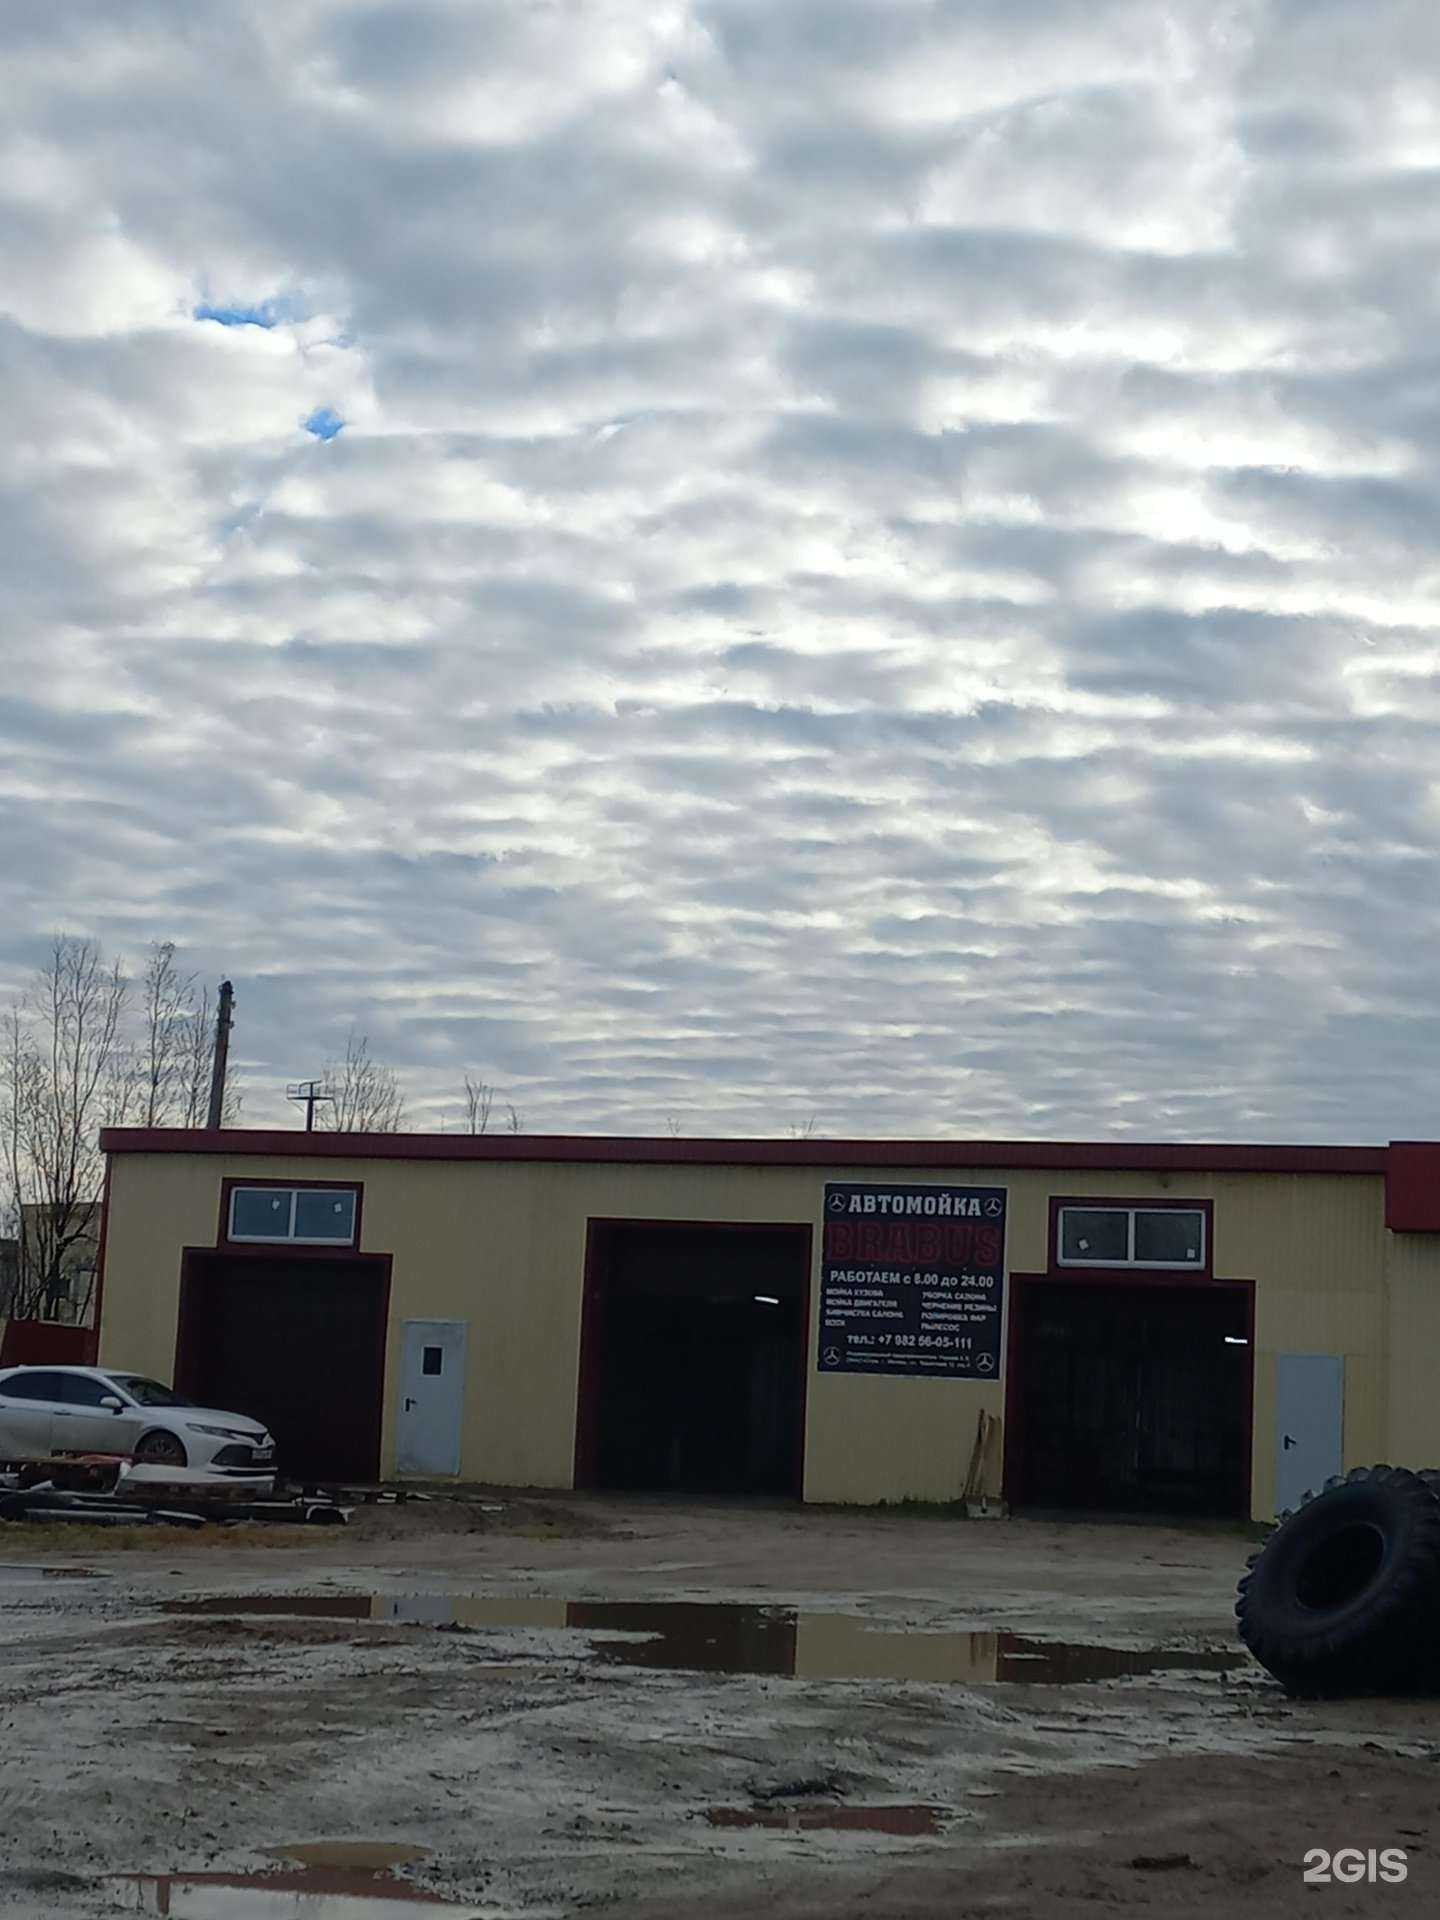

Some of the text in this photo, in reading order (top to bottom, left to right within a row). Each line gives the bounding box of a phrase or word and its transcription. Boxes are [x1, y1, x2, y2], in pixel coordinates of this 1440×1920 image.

[848, 1193, 982, 1216] АВТОМОЙКА
[827, 1222, 1000, 1265] BRABUS
[830, 1270, 900, 1284] РАБОТАЕМ
[941, 1276, 958, 1288] до
[961, 1275, 994, 1288] 24.00
